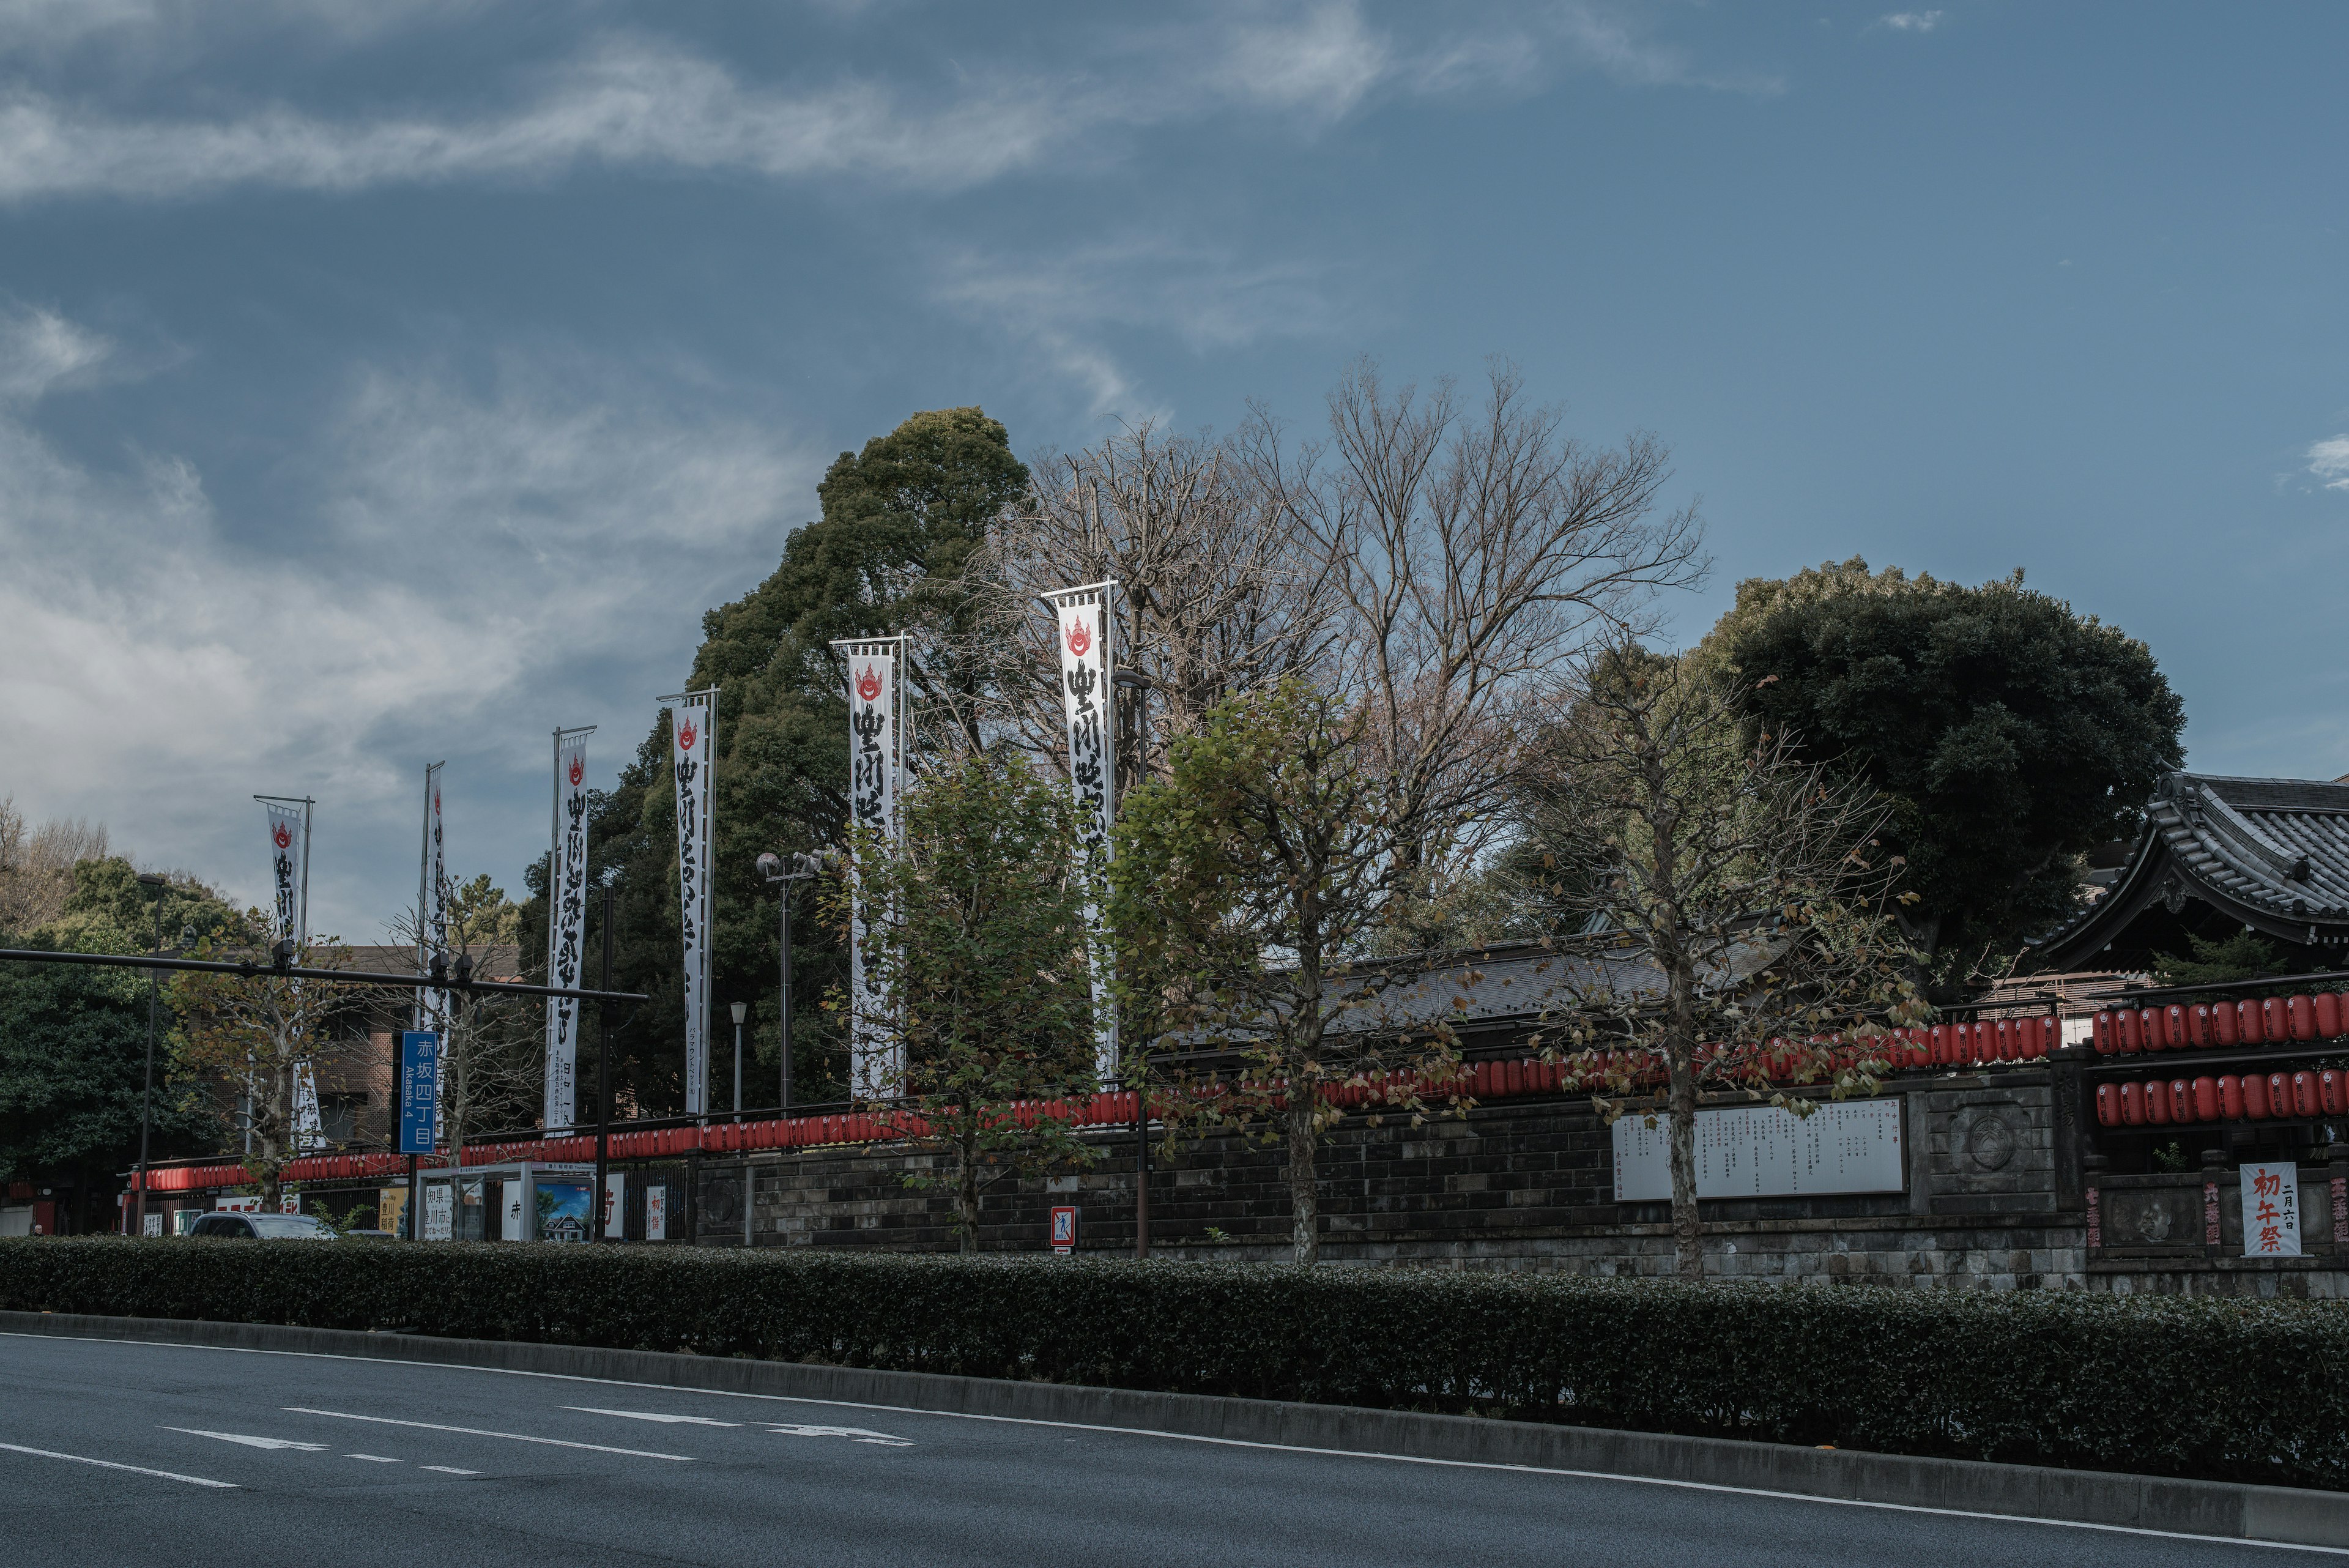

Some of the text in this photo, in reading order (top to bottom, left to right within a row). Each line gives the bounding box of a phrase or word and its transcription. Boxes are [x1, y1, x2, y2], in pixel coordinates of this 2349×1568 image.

[406, 1066, 415, 1107] Akasaka
[416, 1040, 433, 1144] 赤坂四丁目
[381, 1203, 395, 1216] 豊川
[427, 1187, 443, 1204] 知県
[651, 1195, 660, 1230] 初詣
[2084, 1186, 2101, 1248] 七番組
[2203, 1181, 2221, 1245] 六番組
[2253, 1169, 2282, 1252] 初午祭
[2282, 1184, 2295, 1230] 二月六日
[380, 1217, 395, 1231] 稲荷
